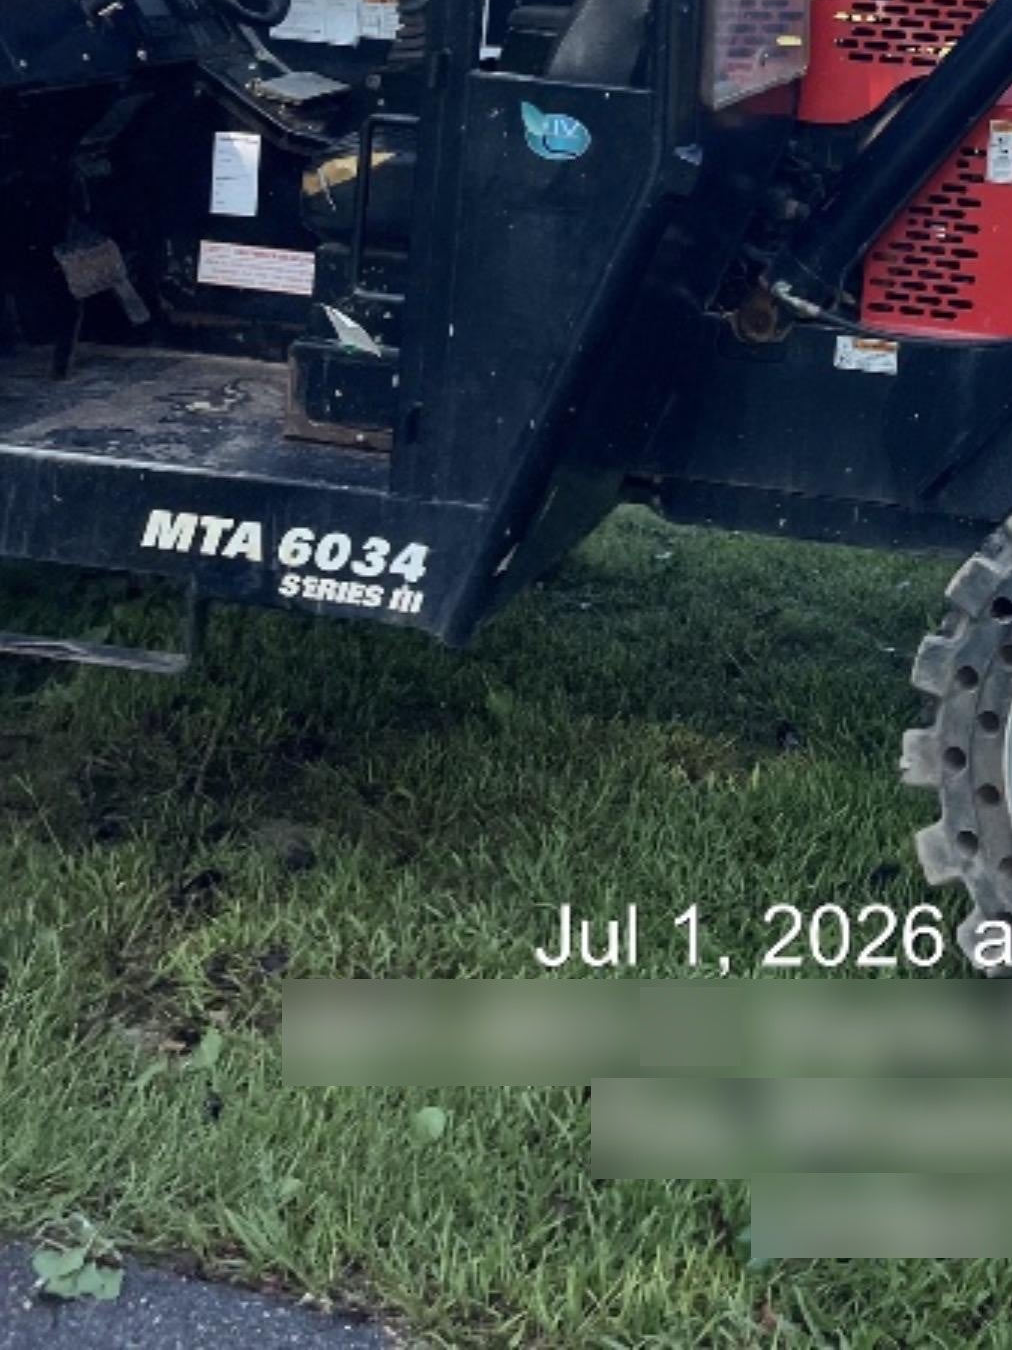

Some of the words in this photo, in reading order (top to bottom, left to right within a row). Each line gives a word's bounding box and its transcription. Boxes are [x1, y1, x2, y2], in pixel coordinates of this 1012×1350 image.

[140, 508, 263, 563] MTA
[277, 526, 430, 583] 6034
[277, 571, 385, 607] SERIES
